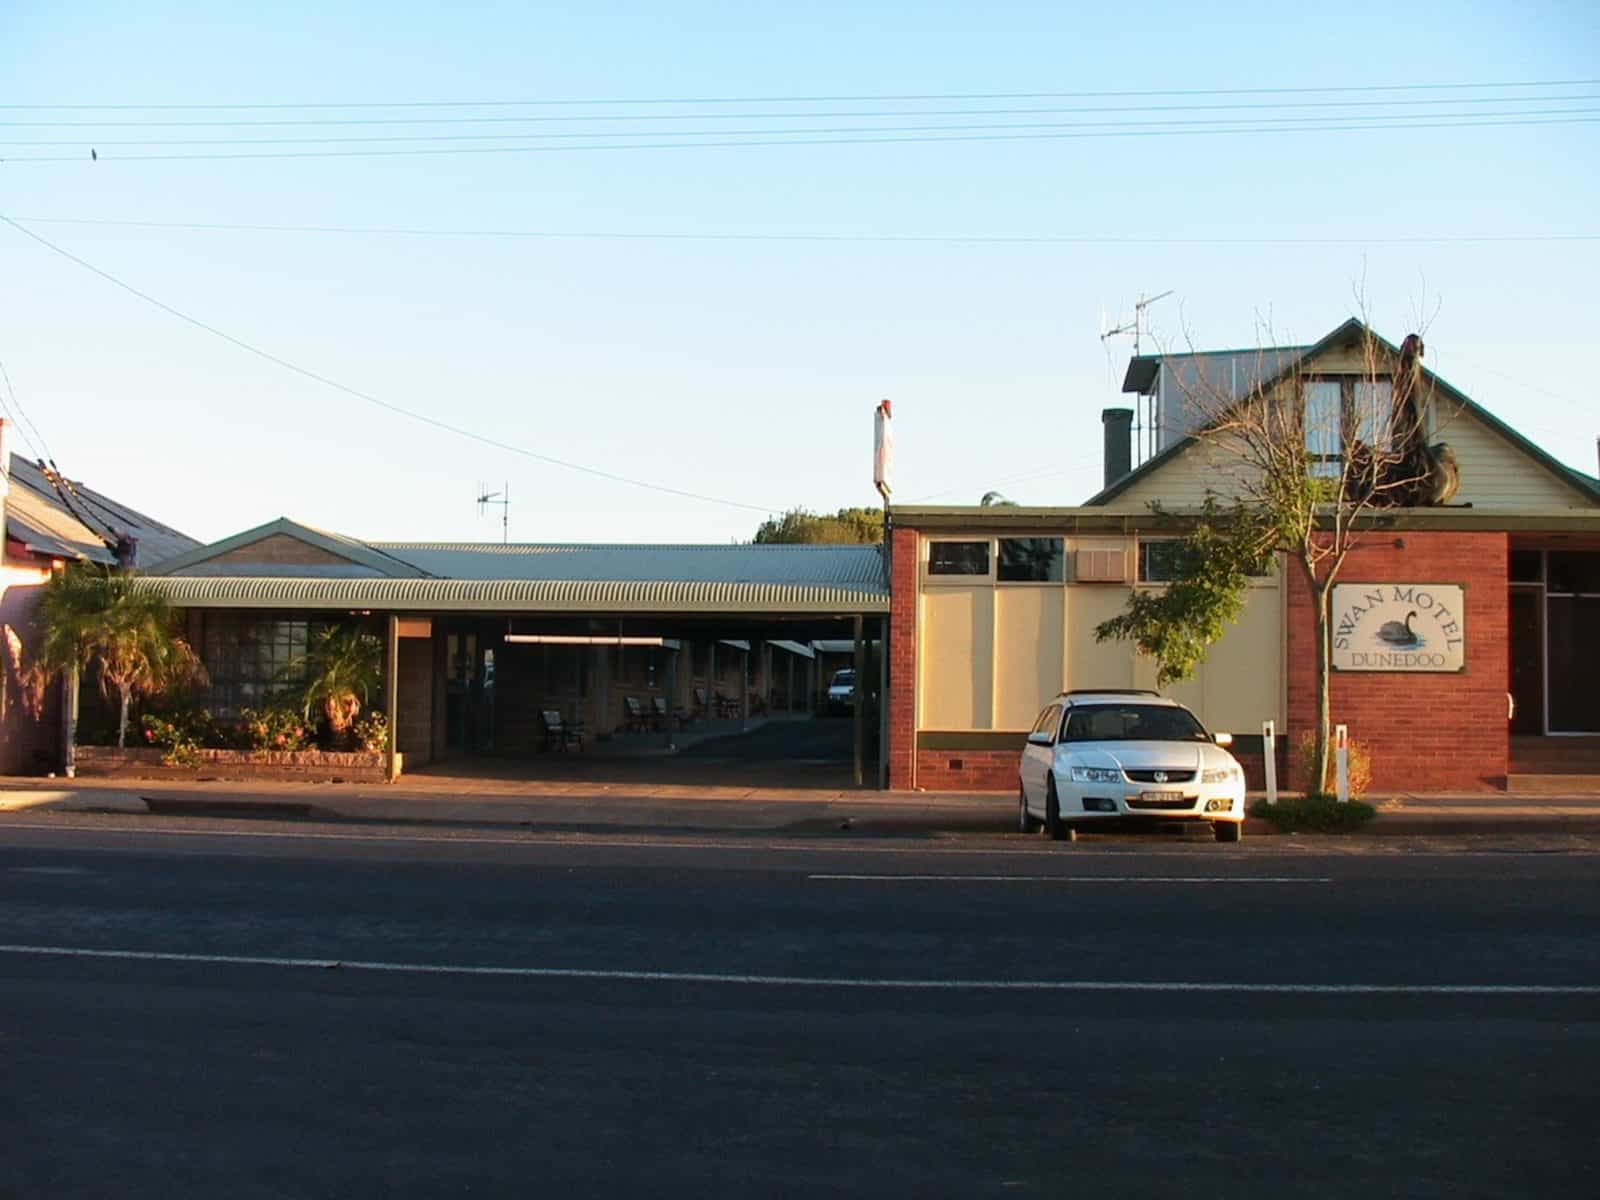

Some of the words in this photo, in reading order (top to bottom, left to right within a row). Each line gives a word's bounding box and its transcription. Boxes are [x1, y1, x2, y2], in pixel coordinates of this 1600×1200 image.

[1335, 589, 1384, 649] SWAN
[1392, 586, 1461, 651] MOTEL
[1351, 652, 1446, 667] DUNEDOO
